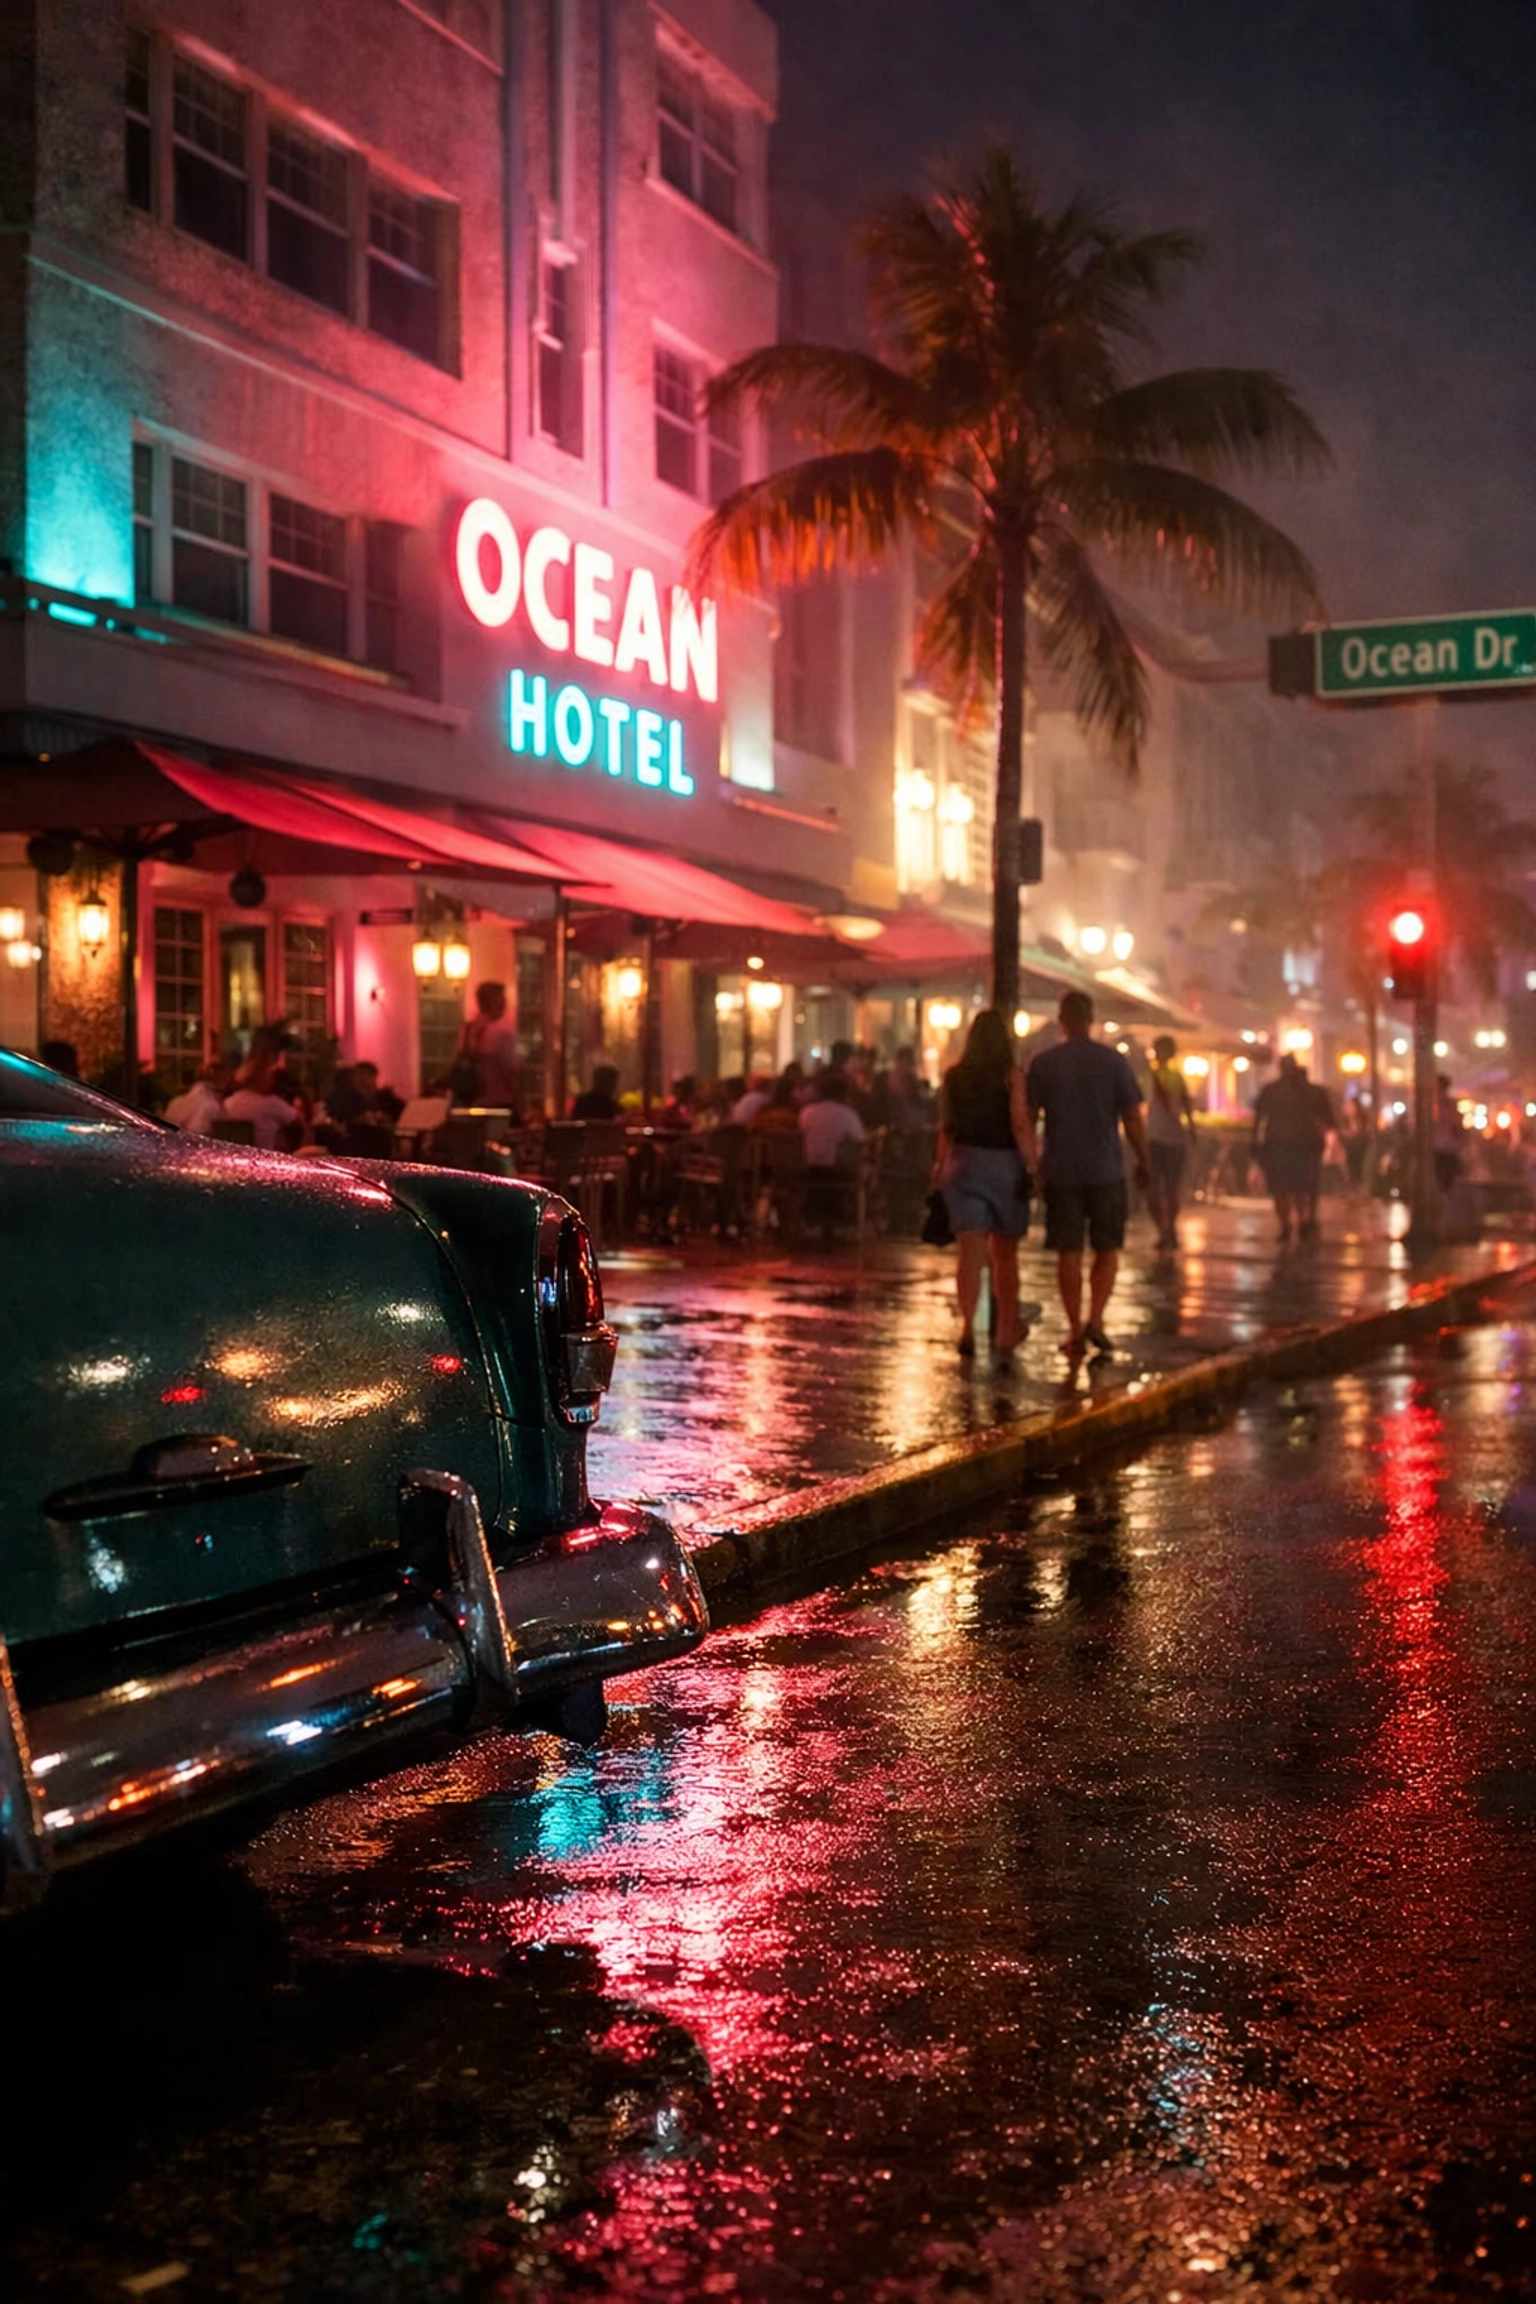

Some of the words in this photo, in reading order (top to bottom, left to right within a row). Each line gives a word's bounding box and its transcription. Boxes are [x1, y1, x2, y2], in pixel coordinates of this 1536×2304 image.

[456, 497, 717, 703] OCEAN
[1341, 636, 1459, 679] Ocean
[1474, 627, 1518, 670] Dr
[509, 668, 695, 797] HOTEL
